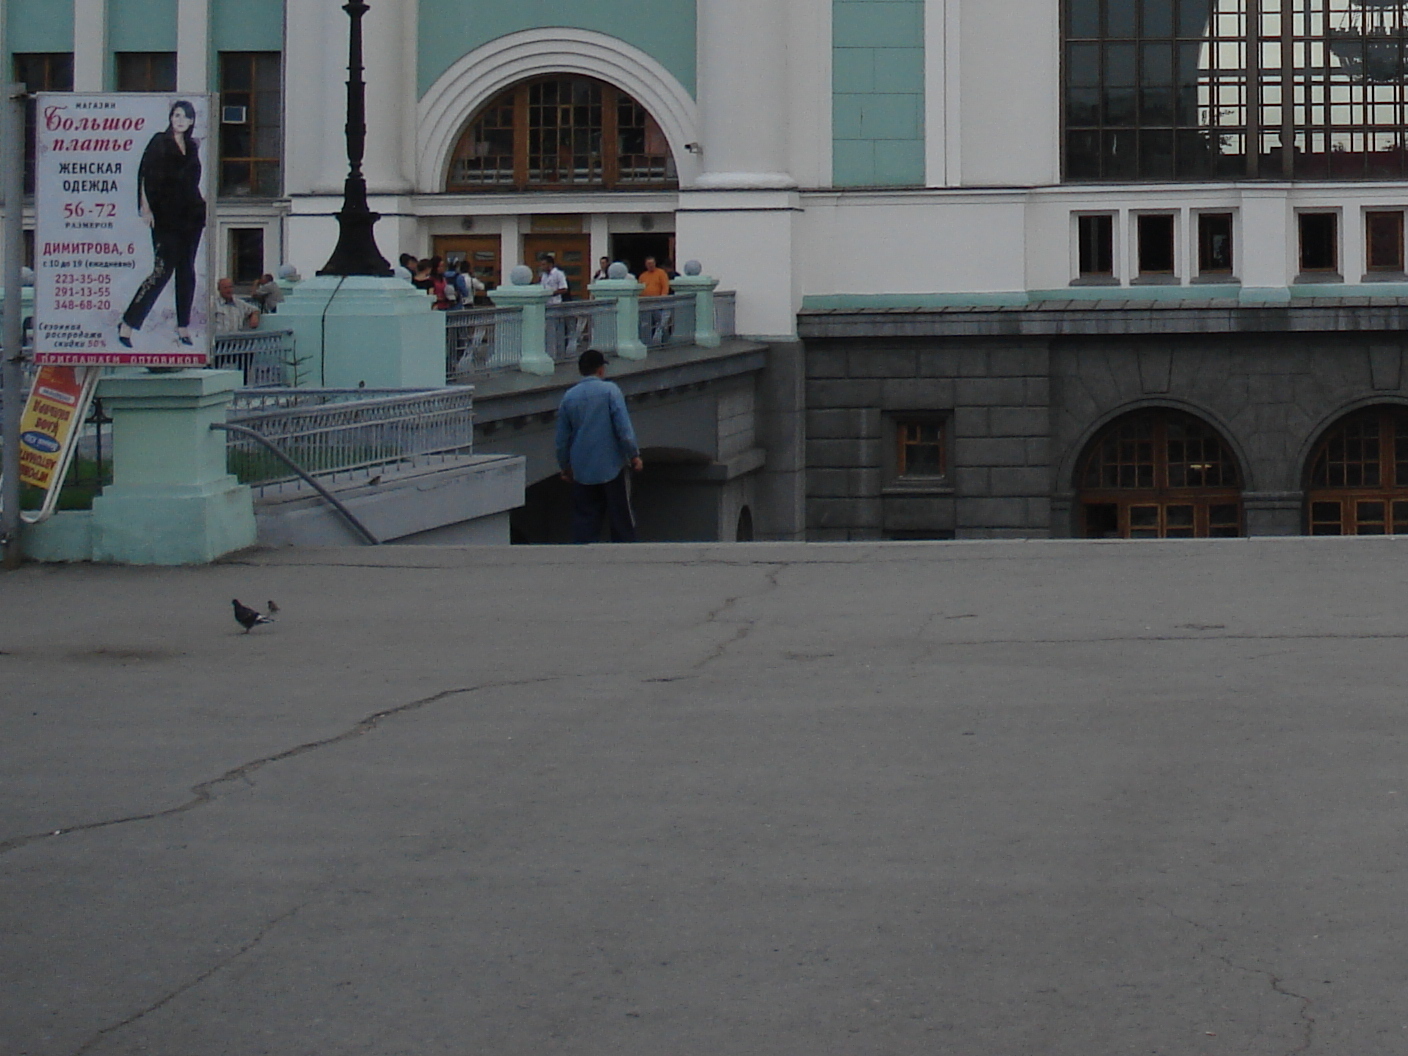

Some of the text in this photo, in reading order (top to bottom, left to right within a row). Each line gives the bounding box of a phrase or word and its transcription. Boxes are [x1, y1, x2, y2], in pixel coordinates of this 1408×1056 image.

[75, 102, 116, 110] МАГАЗИН
[44, 105, 146, 132] Большое
[52, 137, 134, 152] платье
[58, 162, 123, 175] ЖЕНСКАЯ
[62, 179, 118, 193] ОДЕЖДА
[65, 221, 114, 229] РАЗМЕРОВ
[43, 242, 135, 256] ДИМИТРОВА, 6
[49, 259, 60, 268] 10
[73, 259, 83, 268] 19
[85, 259, 136, 269] (ежедневно)
[54, 274, 111, 284] 223-35-05
[54, 287, 111, 297] 291-13-55
[53, 300, 111, 310] 348-68-20
[38, 322, 82, 331] Сезонная
[45, 330, 103, 340] распродажа
[87, 339, 107, 348] 50%
[40, 353, 200, 364] ПРИГЛАШАЕМ ОПТОВИКОВ
